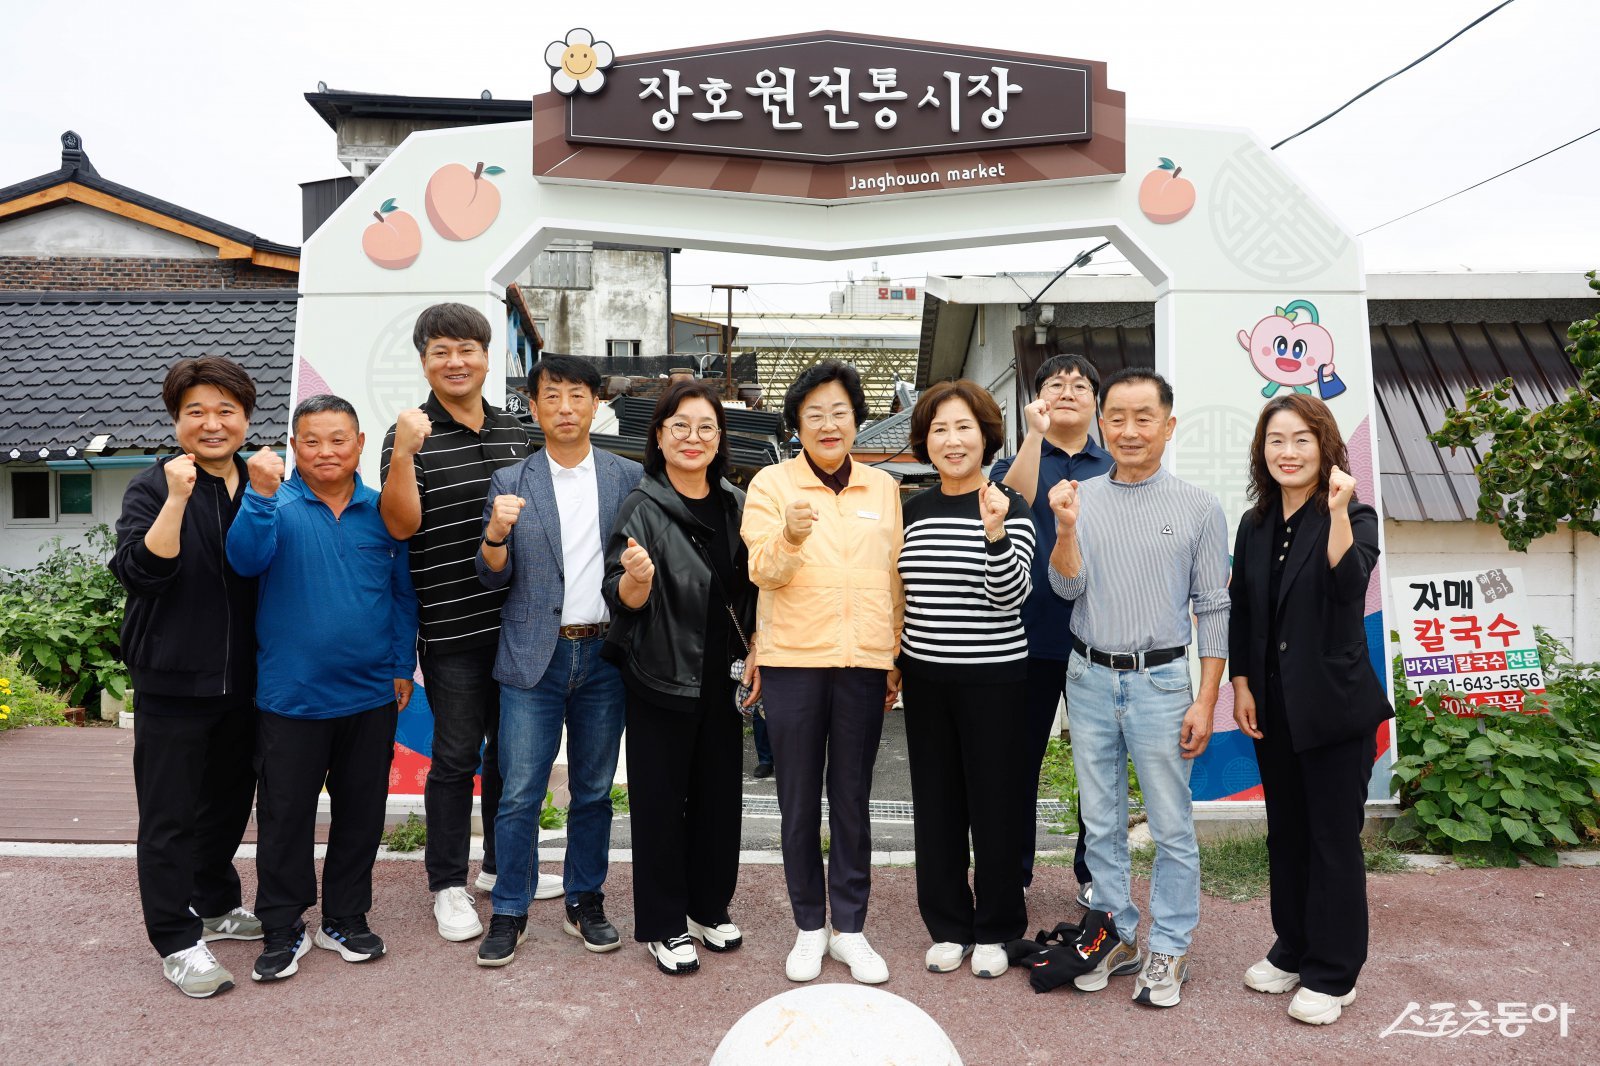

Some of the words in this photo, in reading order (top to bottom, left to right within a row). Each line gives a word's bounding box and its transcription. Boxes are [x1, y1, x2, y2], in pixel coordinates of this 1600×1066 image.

[638, 66, 1024, 133] 장호원전통시장
[849, 171, 940, 192] Janghowon
[947, 162, 1006, 181] market
[1409, 579, 1474, 612] 자매
[1413, 613, 1521, 653] 칼국수
[1405, 657, 1454, 674] 바지락
[1456, 653, 1505, 671] 칼국수
[1507, 650, 1540, 668] 전문
[1428, 672, 1541, 693] 1-643-5556
